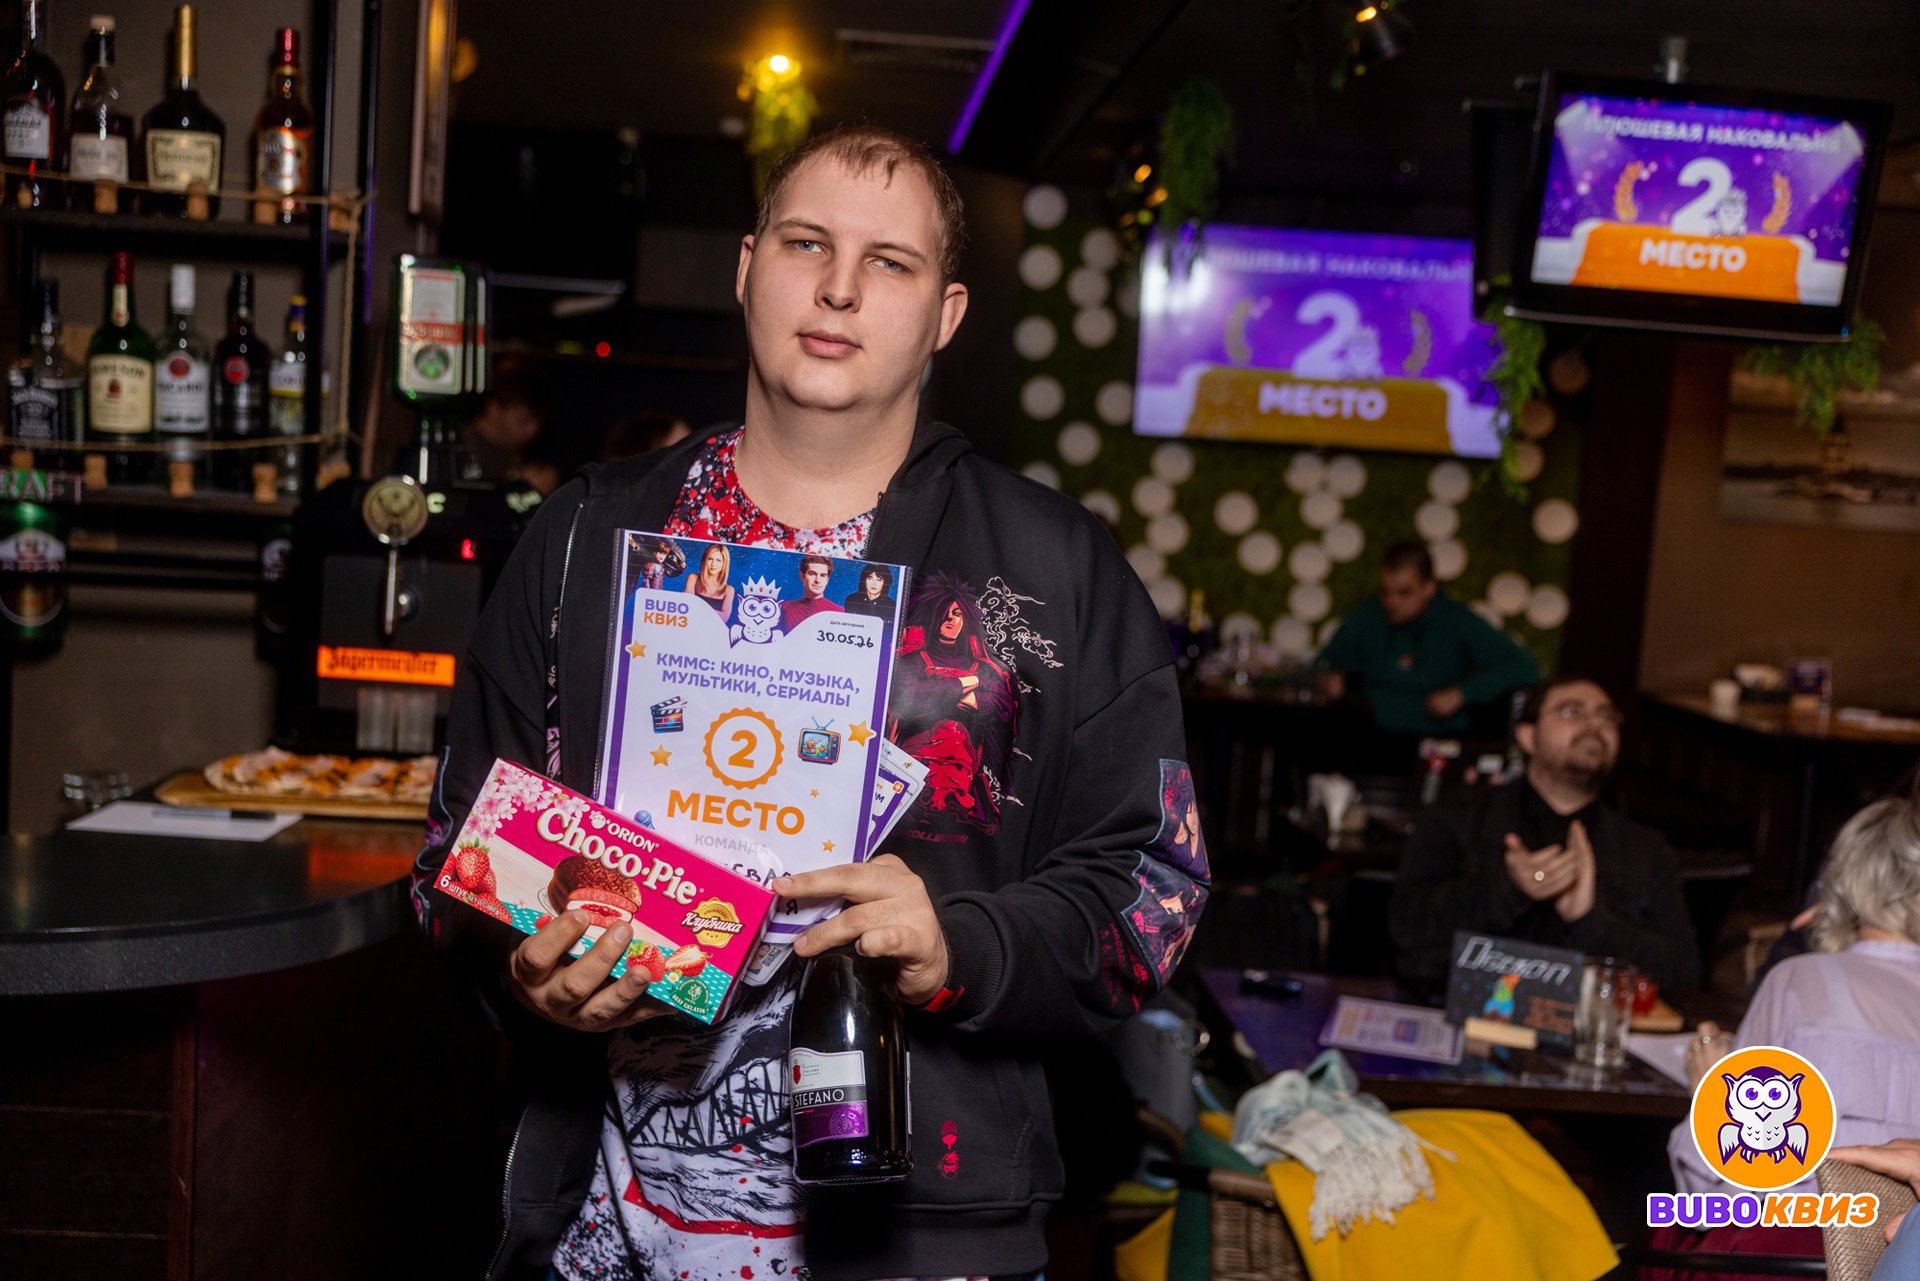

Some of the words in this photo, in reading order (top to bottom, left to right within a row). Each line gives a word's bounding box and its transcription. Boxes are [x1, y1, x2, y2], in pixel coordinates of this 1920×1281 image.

[1670, 156, 1732, 237] 2
[1639, 238, 1747, 273] МЕСТО
[1292, 289, 1361, 380] 2
[1257, 380, 1388, 421] МЕСТО
[643, 611, 688, 628] КВИЗ
[644, 598, 689, 615] BUBO
[816, 629, 875, 648] 30.05.26
[656, 653, 716, 672] КММС:
[720, 660, 774, 681] КИНО,
[778, 668, 861, 694] МУЗЫКА,
[661, 669, 761, 697] МУЛЬТИКИ,
[765, 683, 851, 708] СЕРИАЛЫ
[728, 729, 758, 769] 2
[667, 789, 805, 836] МЕСТО
[606, 821, 655, 854] ORION
[694, 834, 769, 857] КОМАНДА
[440, 874, 451, 888] 6
[448, 883, 468, 898] ШТУК
[681, 911, 743, 933] Клубника
[794, 1088, 845, 1108] STEFANO
